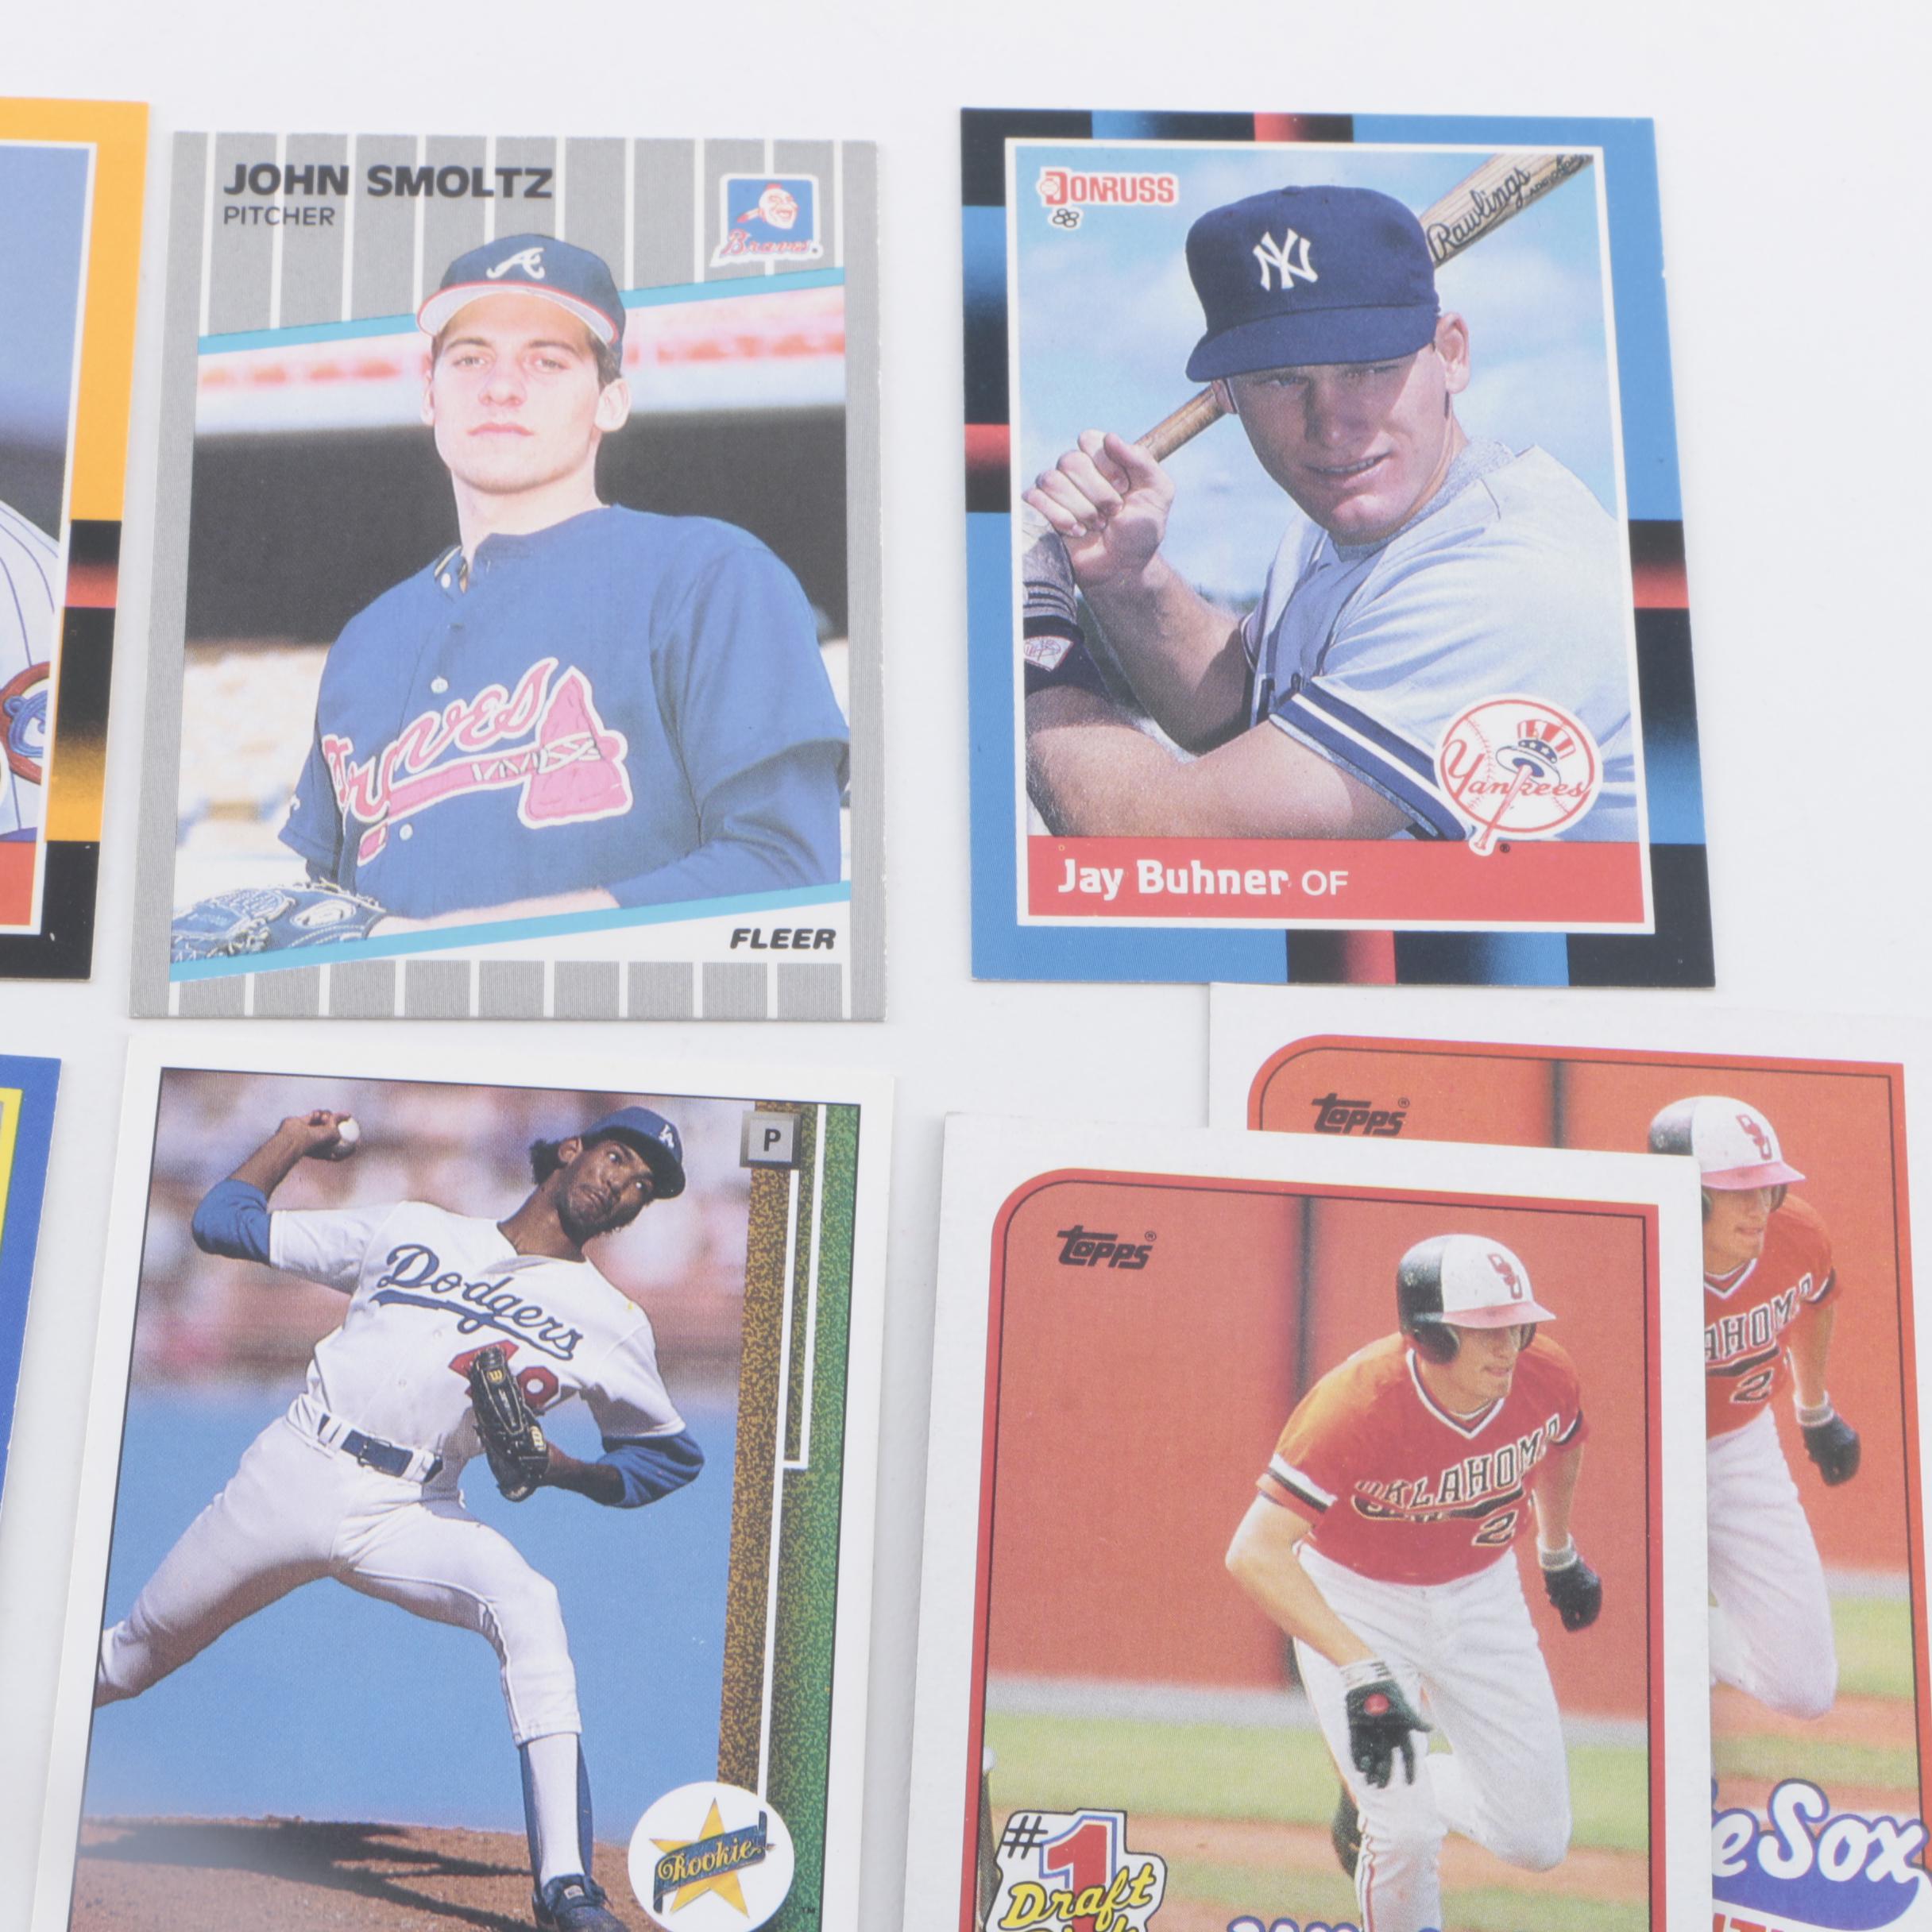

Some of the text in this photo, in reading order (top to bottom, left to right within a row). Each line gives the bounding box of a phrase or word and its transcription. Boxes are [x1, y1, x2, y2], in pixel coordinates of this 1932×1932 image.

[223, 163, 553, 199] JOHN SMOLTZ
[1041, 170, 1175, 205] DONRUSS
[223, 206, 335, 226] PITCHER
[1427, 166, 1531, 262] Rawlings
[1252, 227, 1319, 292] NY
[1442, 739, 1590, 800] Yankees
[1057, 858, 1349, 901] Jay Buhner OF
[730, 928, 837, 949] FLEER
[763, 1128, 781, 1152] P
[377, 1243, 584, 1353] Dodgers
[1729, 1366, 1775, 1404] 2
[1471, 1508, 1519, 1547] 2
[657, 1837, 763, 1883] Rookie
[998, 1862, 1157, 1932] Draft
